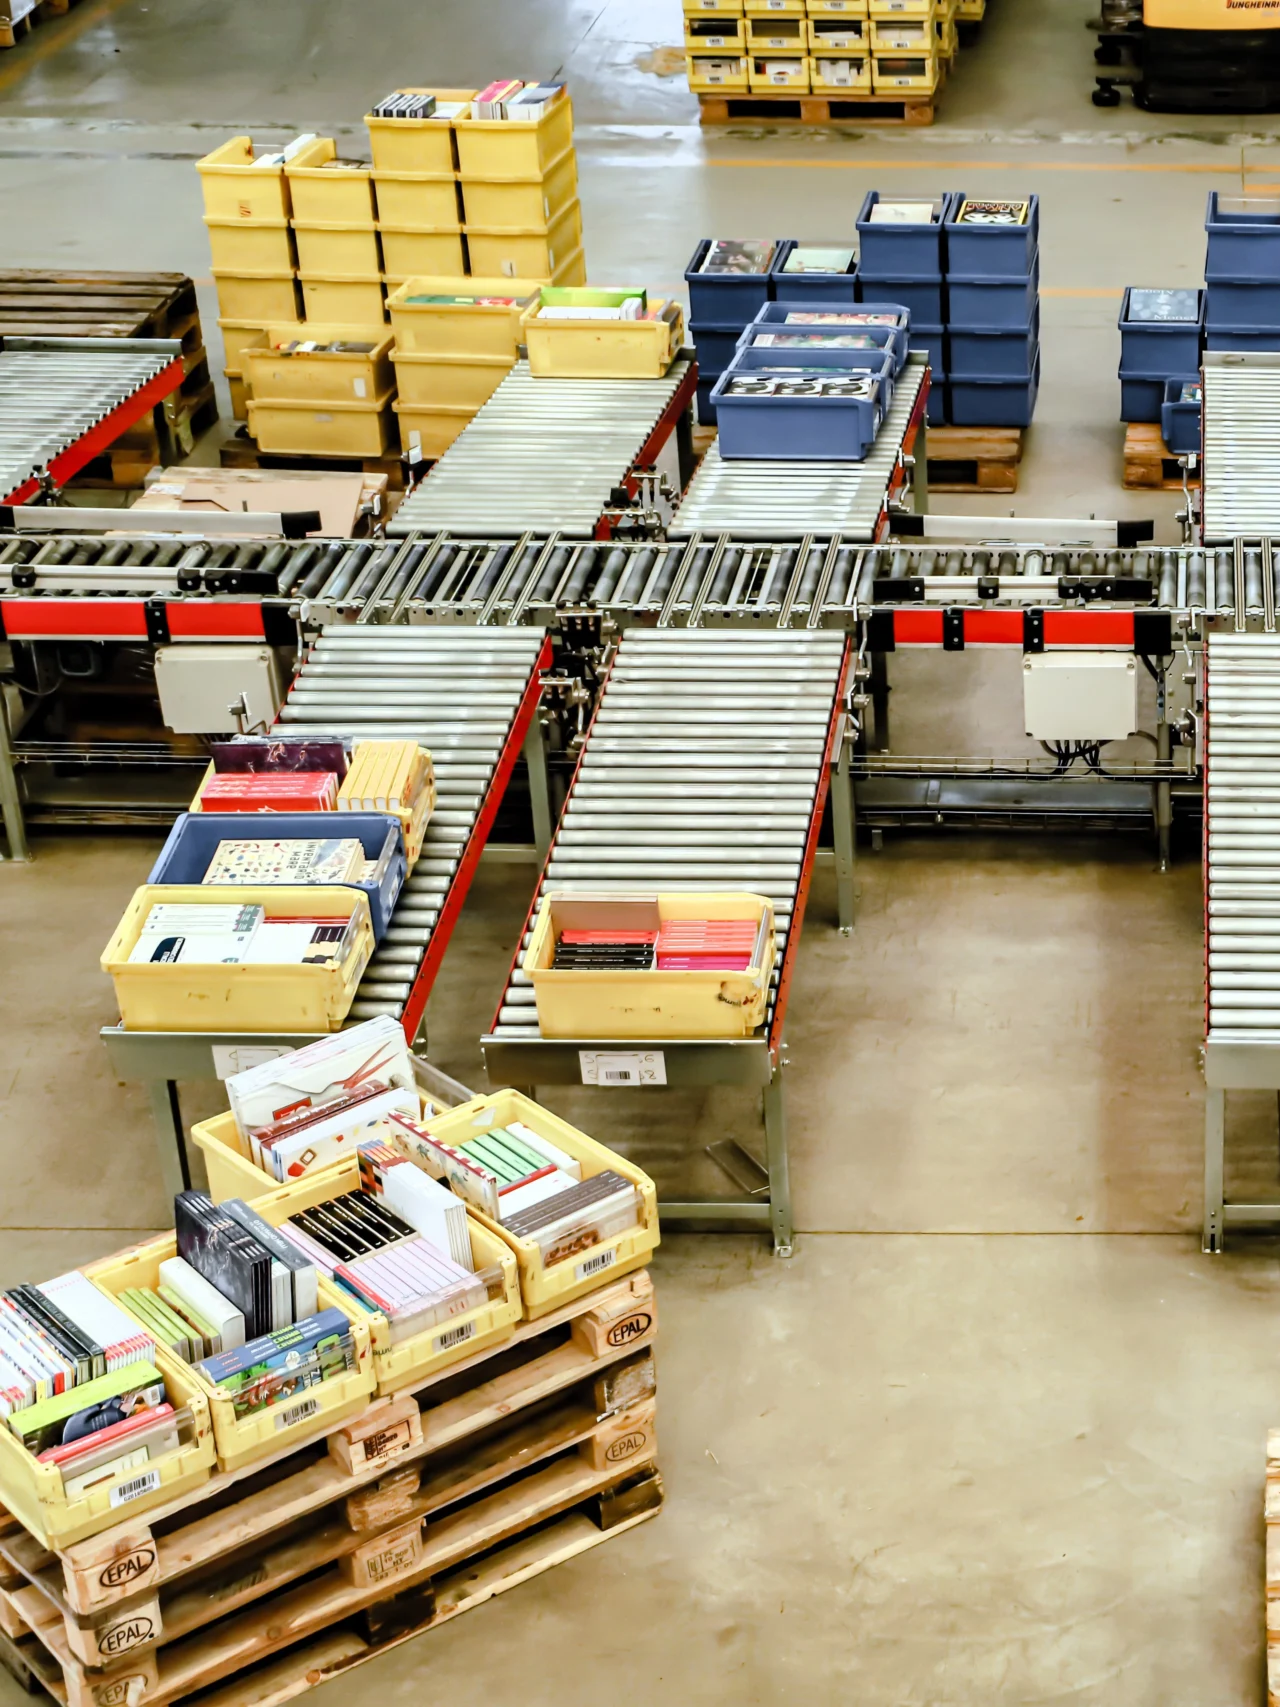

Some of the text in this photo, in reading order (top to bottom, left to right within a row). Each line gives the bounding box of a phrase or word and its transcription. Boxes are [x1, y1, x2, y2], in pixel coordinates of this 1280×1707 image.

[613, 1319, 646, 1344] EPAL
[611, 1435, 641, 1459] EPAL
[106, 1555, 149, 1585] EPAL
[106, 1624, 146, 1652] EPAL
